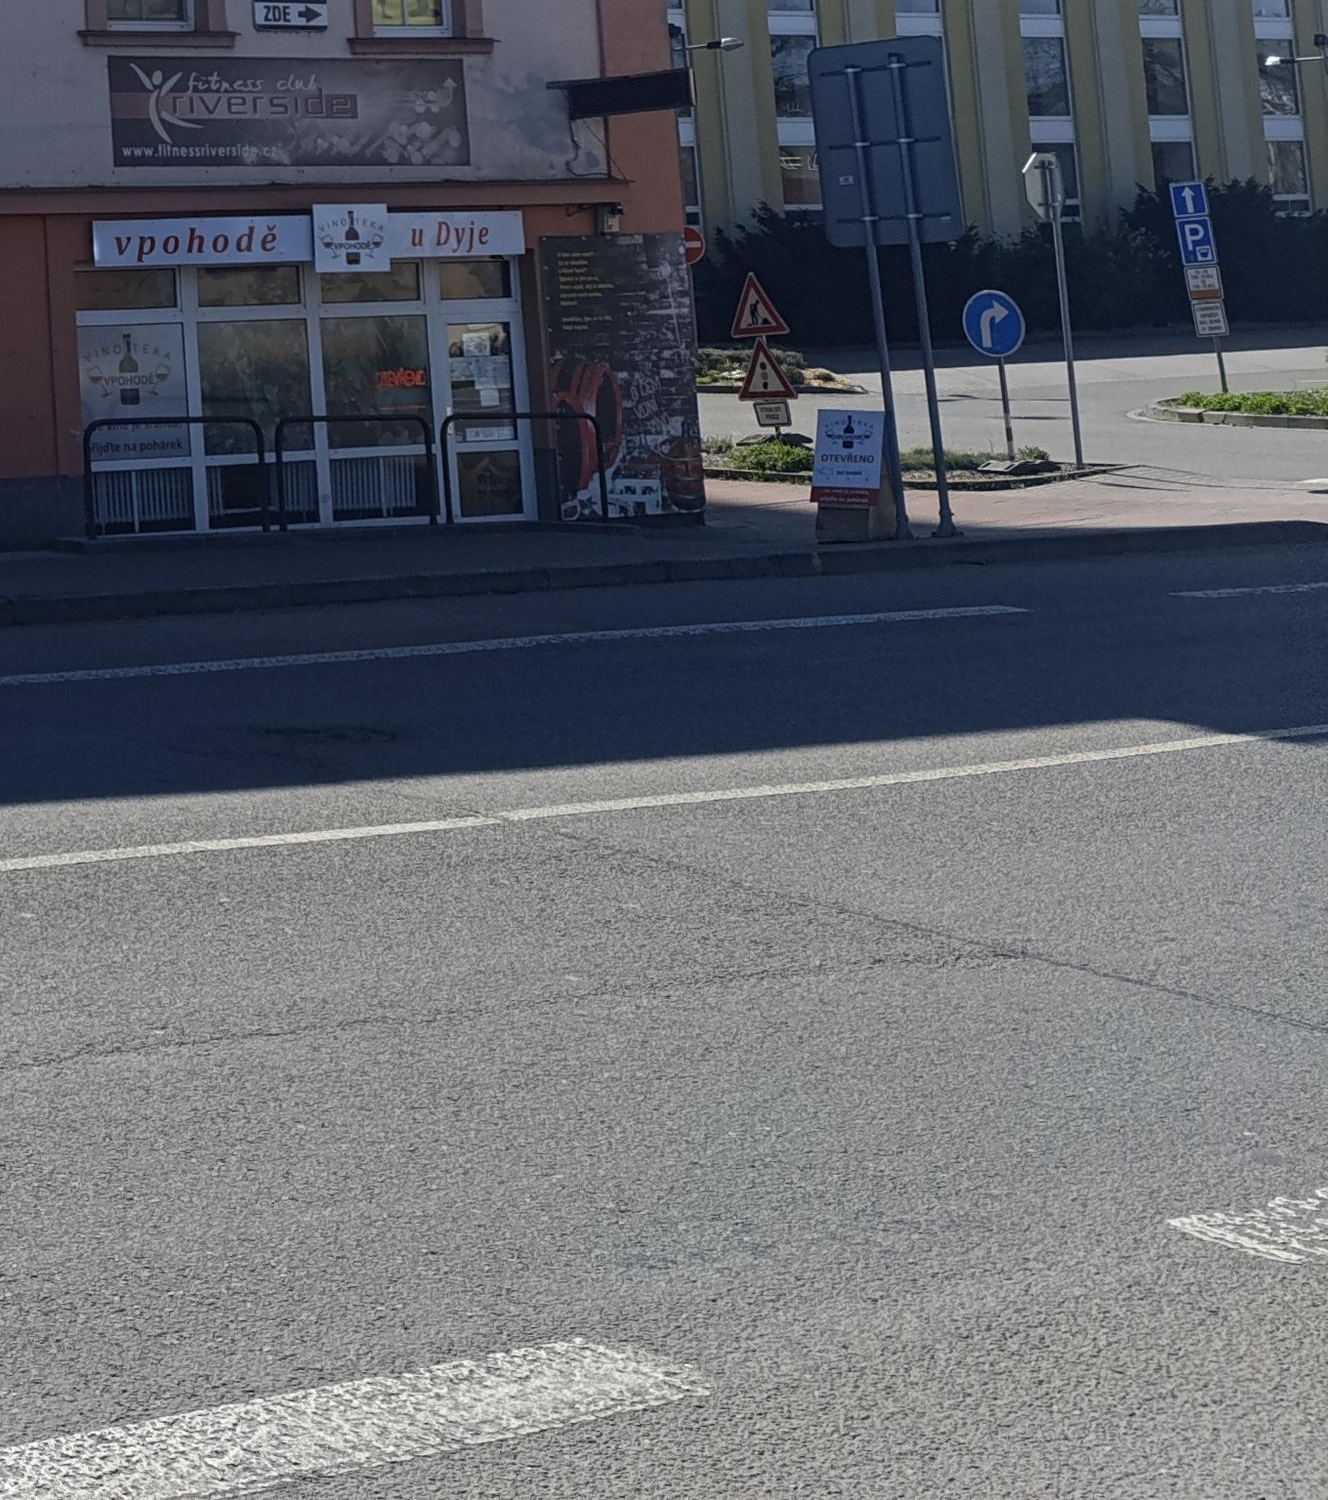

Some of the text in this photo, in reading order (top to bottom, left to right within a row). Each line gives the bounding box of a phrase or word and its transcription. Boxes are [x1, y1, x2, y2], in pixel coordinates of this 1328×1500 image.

[263, 5, 292, 23] ZDE
[187, 70, 319, 96] fitness club
[171, 89, 352, 118] riverside
[121, 143, 278, 160] www.fitnessriverside.cz
[114, 224, 279, 262] vpohodě
[411, 219, 490, 254] u Dyje
[1184, 223, 1205, 252] P
[104, 373, 158, 387] VPOHODĚ
[124, 443, 137, 452] na
[140, 438, 184, 454] pohárek
[821, 451, 875, 465] OTEVŘENO
